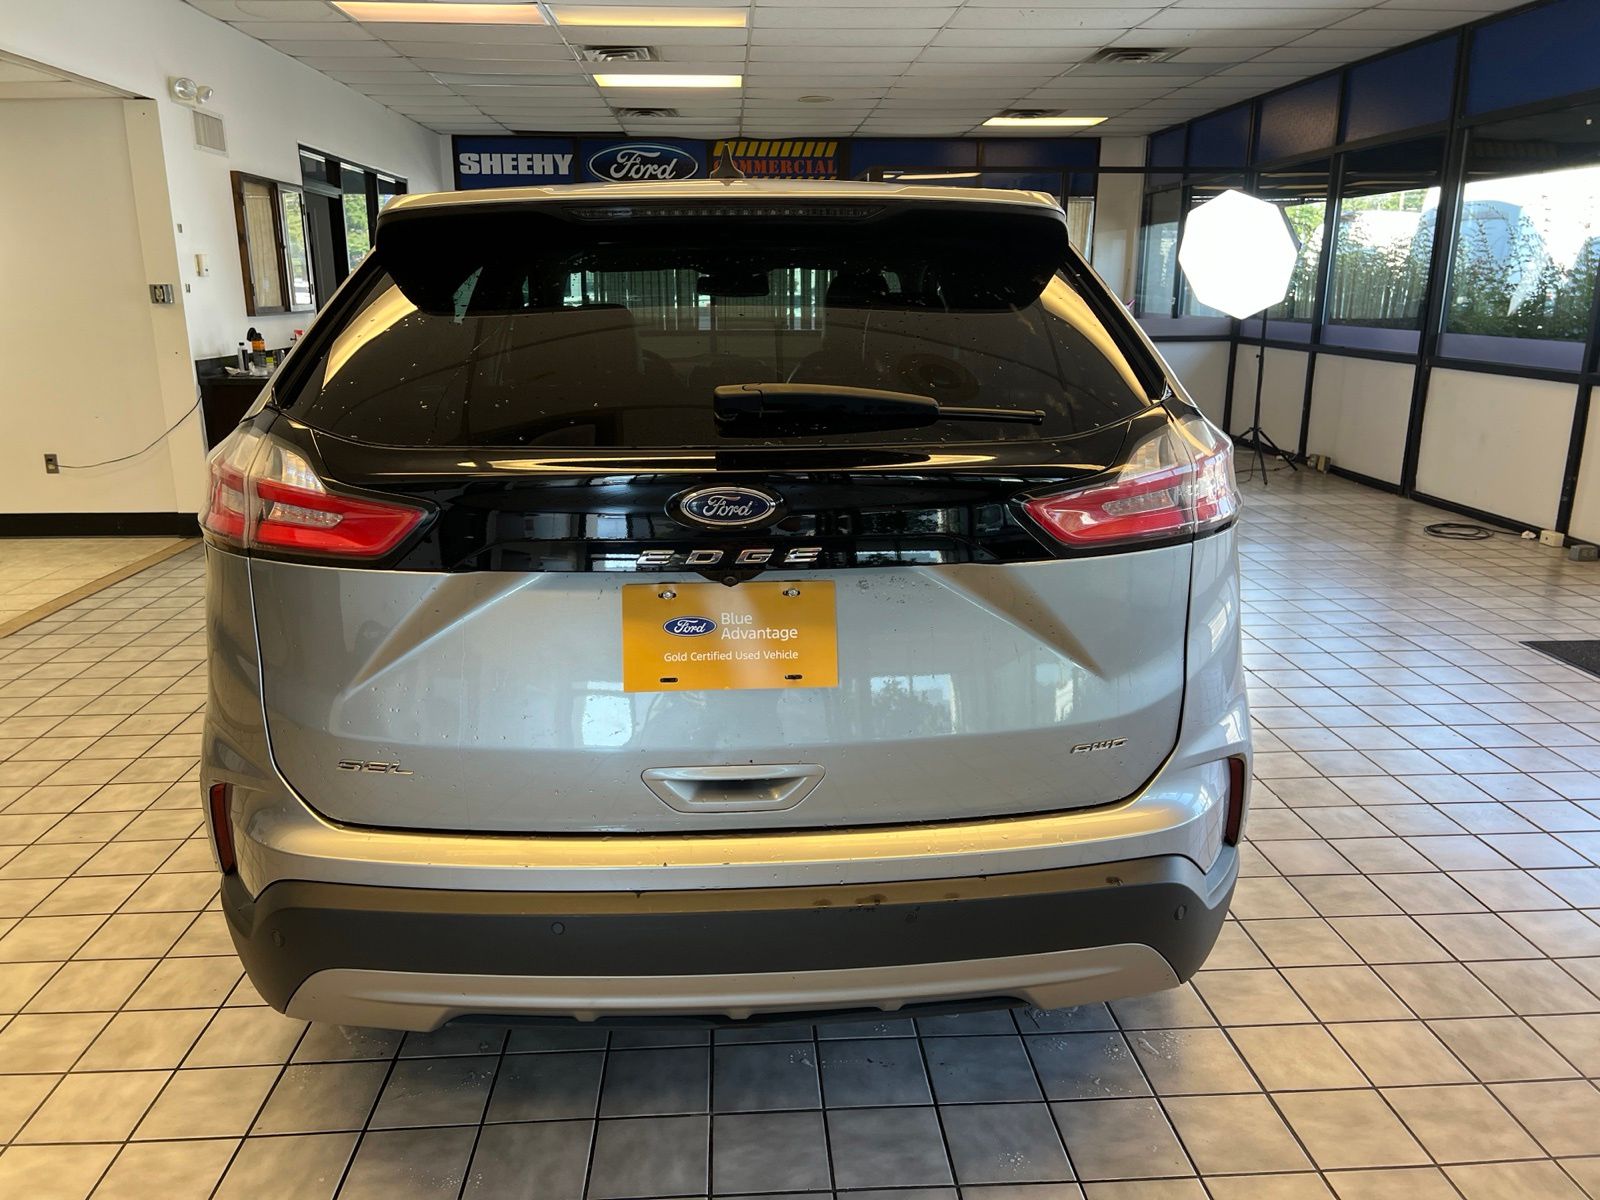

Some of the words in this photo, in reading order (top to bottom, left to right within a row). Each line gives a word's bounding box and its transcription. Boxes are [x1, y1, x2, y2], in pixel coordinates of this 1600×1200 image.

[459, 153, 573, 175] SHEEHY
[610, 150, 678, 179] Ford
[713, 159, 838, 174] MMERCIAL
[702, 495, 753, 517] Ford
[636, 547, 822, 565] EDGE
[721, 612, 753, 625] Blue
[673, 620, 706, 634] Ford
[721, 627, 798, 641] Advantage
[664, 652, 688, 662] Gold
[690, 651, 732, 661] Certified
[735, 651, 760, 660] Used
[763, 650, 799, 660] Vehicle
[336, 759, 414, 775] SEL
